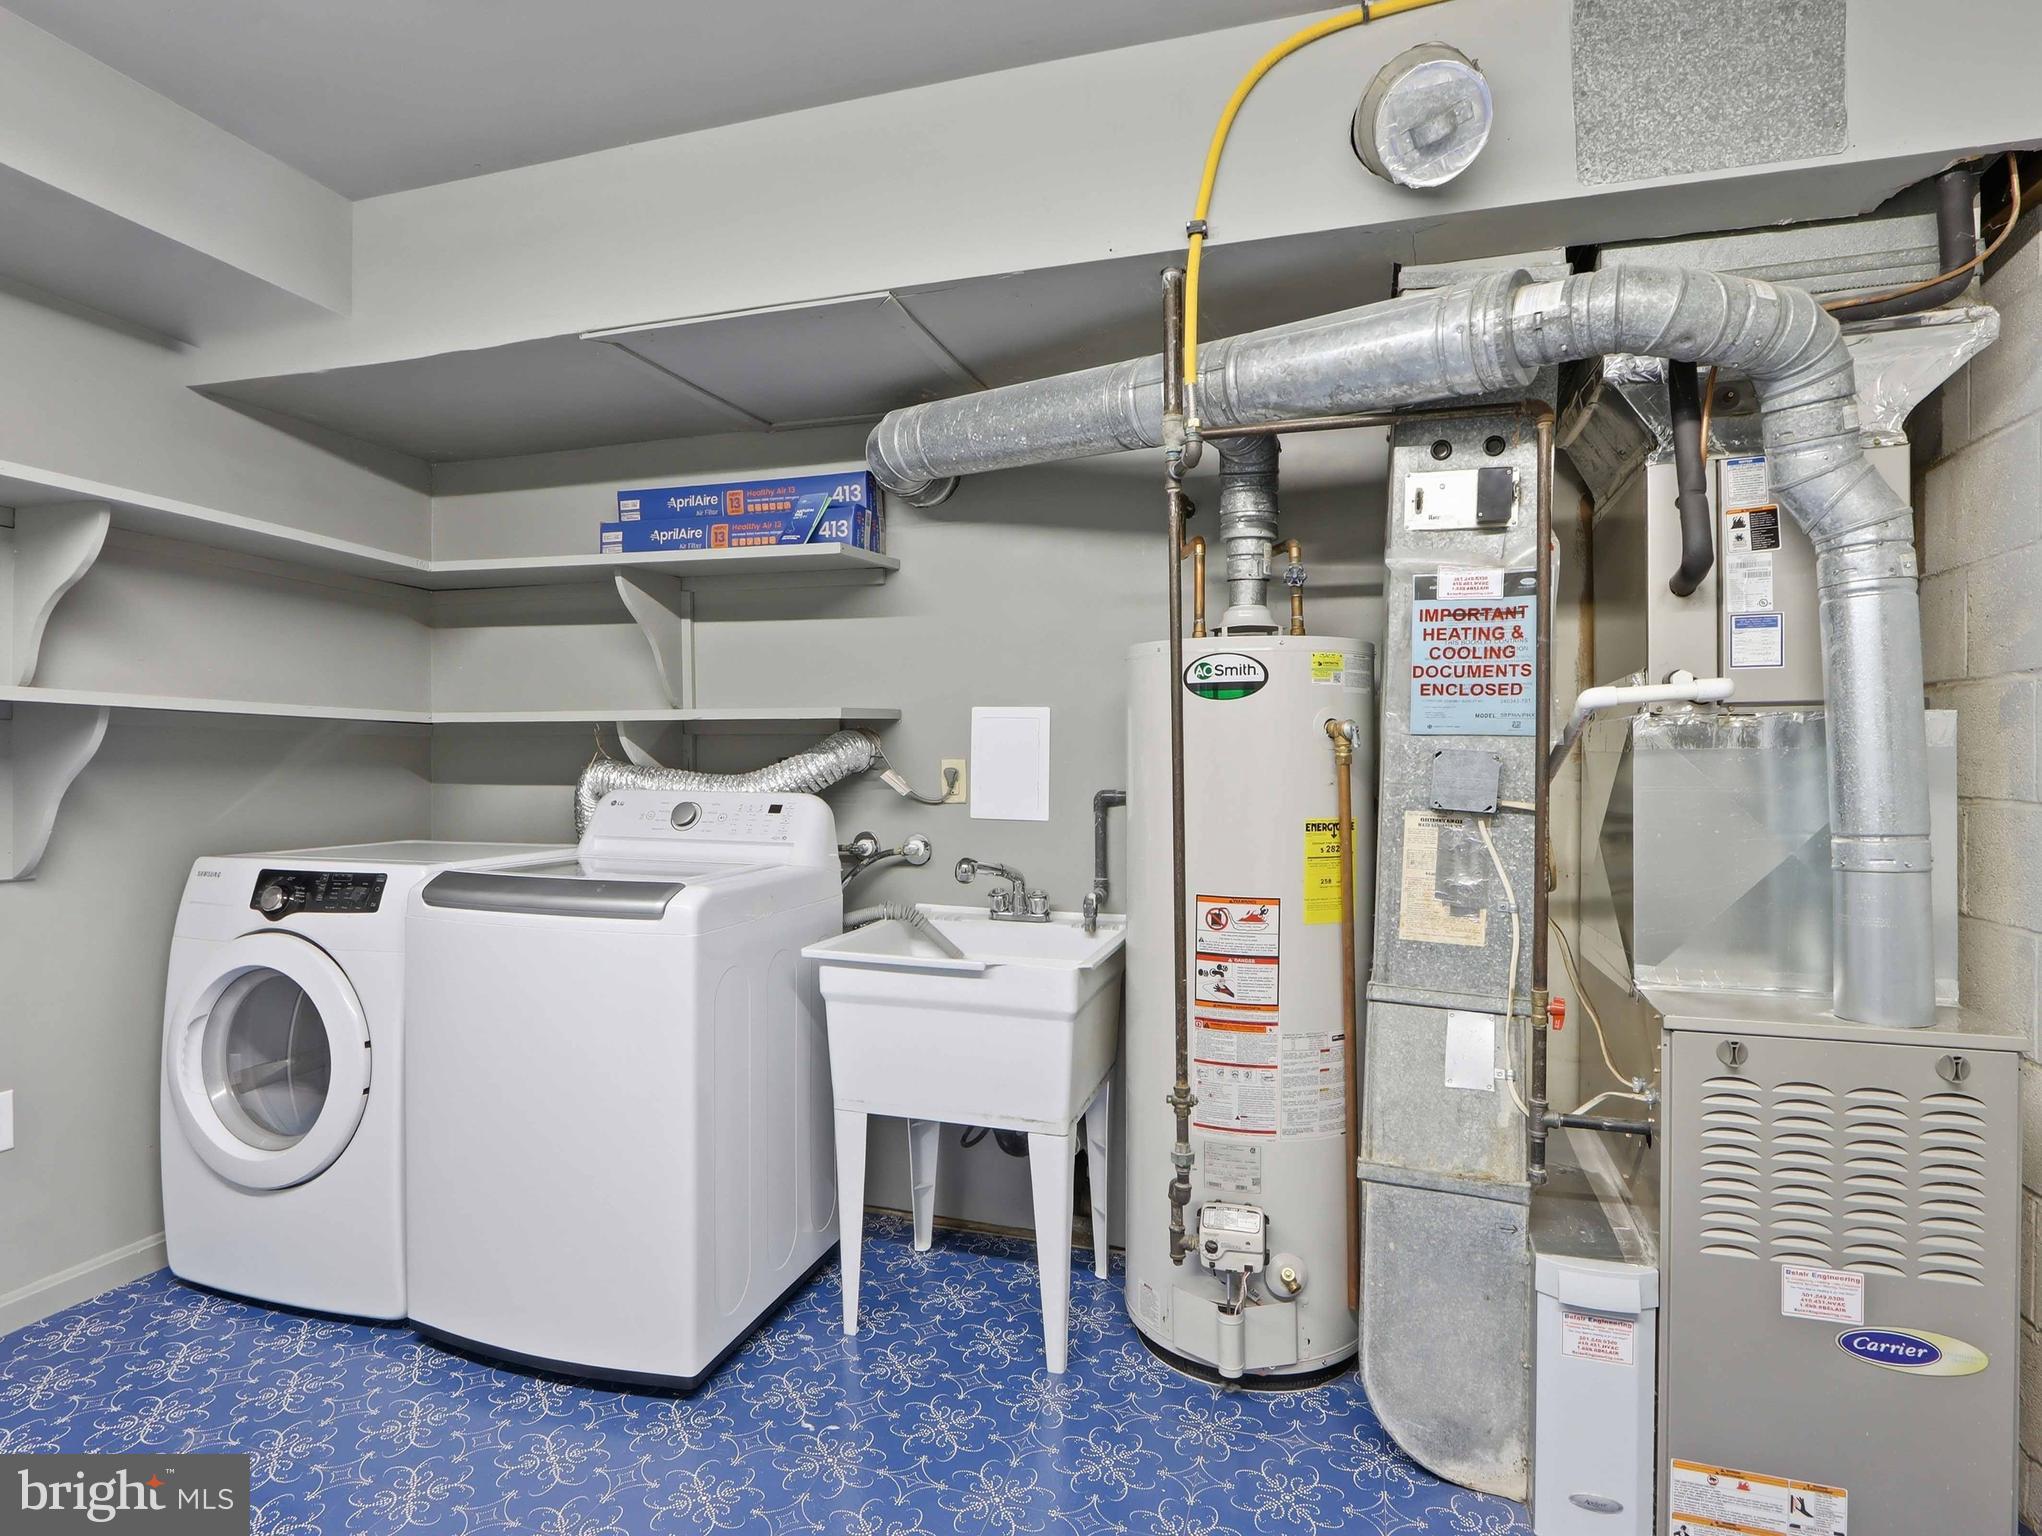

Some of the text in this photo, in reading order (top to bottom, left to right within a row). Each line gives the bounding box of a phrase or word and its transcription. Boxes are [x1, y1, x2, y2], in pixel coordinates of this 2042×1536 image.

[776, 487, 786, 495] Air
[788, 486, 796, 494] 13
[832, 484, 861, 502] 413
[667, 494, 718, 512] AprilAire
[763, 521, 773, 529] Air
[819, 519, 848, 537] 413
[650, 527, 702, 544] AprilAire
[714, 532, 724, 543] 13
[1419, 605, 1528, 622] IMPORTANT
[1423, 625, 1524, 641] HEATING &
[1429, 645, 1516, 660] COOLING
[1412, 664, 1532, 679] DOCUMENTS
[1420, 683, 1523, 697] ENCLOSED
[1326, 845, 1340, 853] 282
[1811, 1272, 1861, 1284] Engineering
[1852, 1336, 1929, 1358] Carrier
